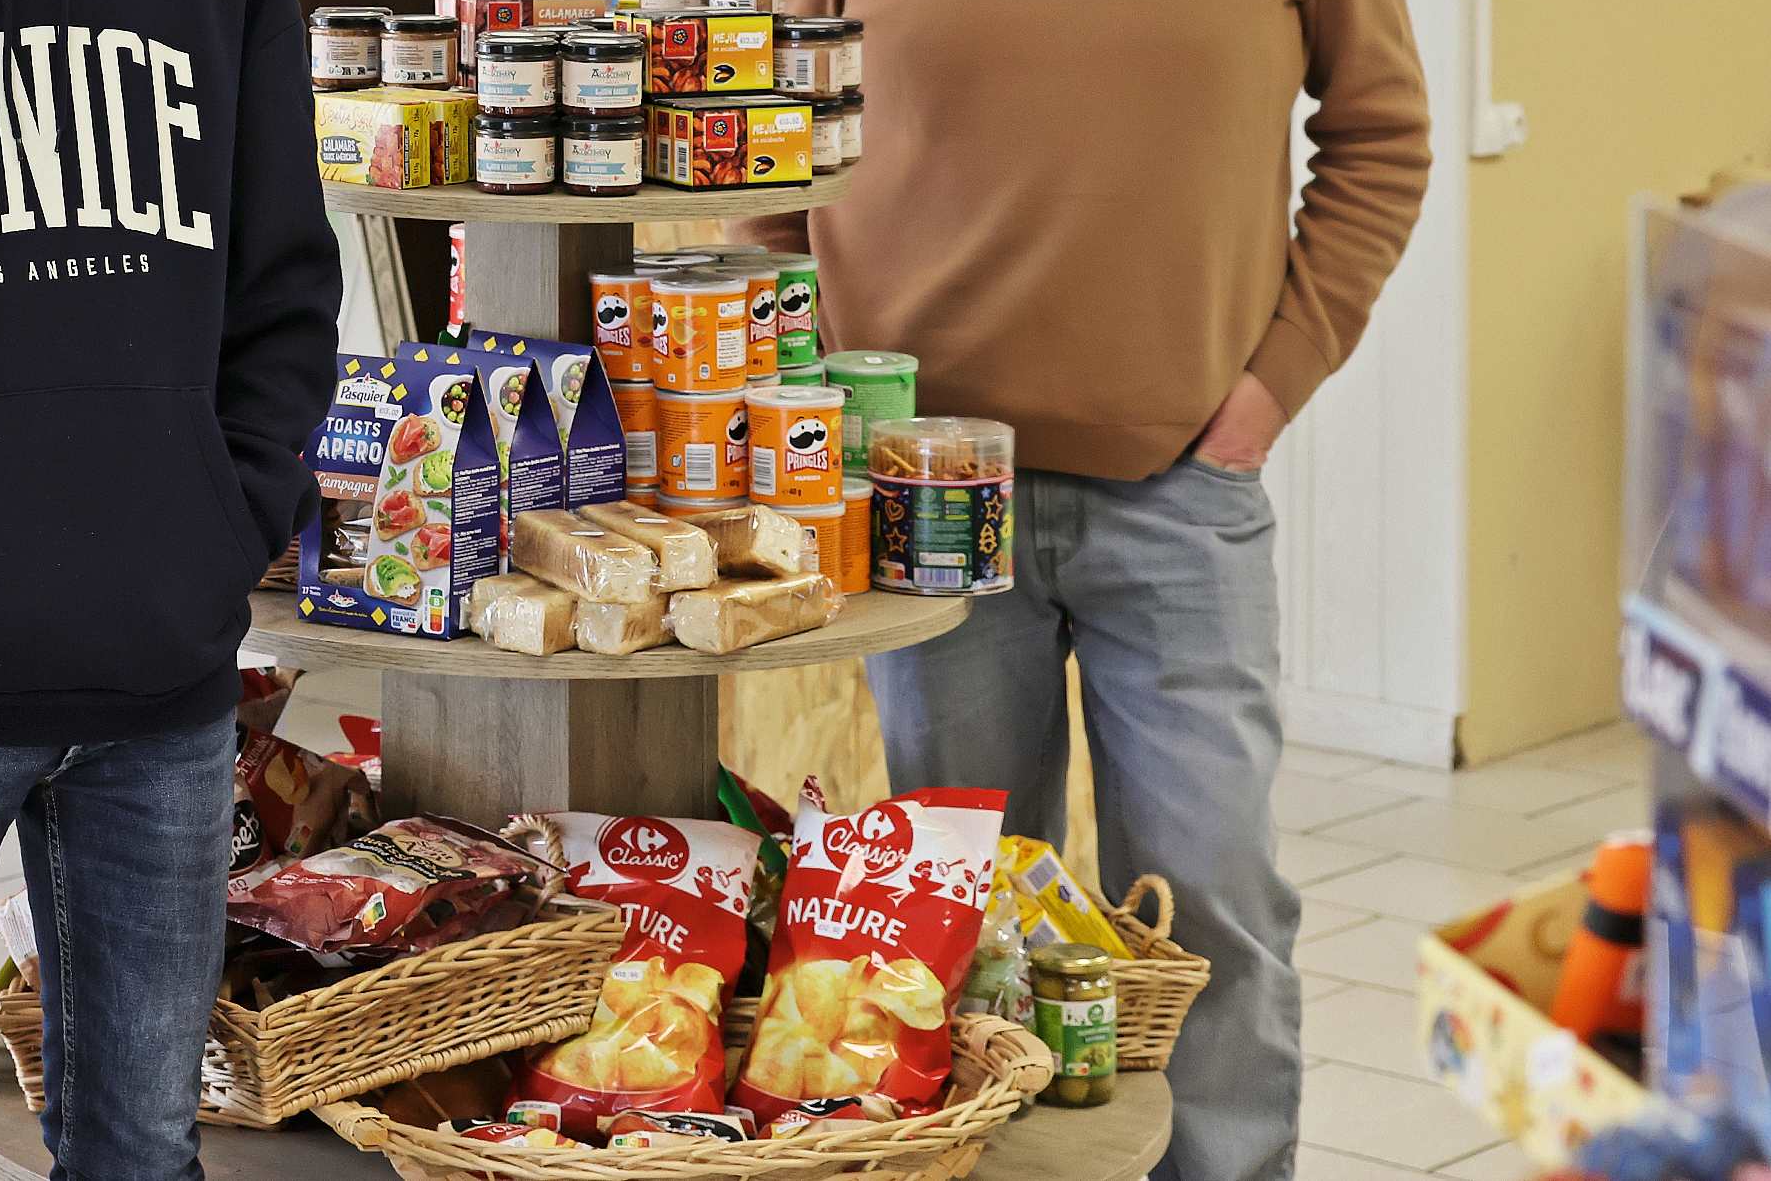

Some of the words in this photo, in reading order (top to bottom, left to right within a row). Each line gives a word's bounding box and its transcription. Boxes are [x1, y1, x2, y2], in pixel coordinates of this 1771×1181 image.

[539, 7, 595, 19] CALAMARES
[323, 137, 356, 152] CALAMARS
[28, 254, 150, 282] ANGELES
[340, 385, 386, 404] Pasquier
[326, 416, 382, 438] TOASTS
[316, 436, 384, 465] APERO
[787, 449, 829, 472] PRINGLES
[317, 472, 375, 498] Campagne
[607, 846, 683, 869] Classic
[620, 902, 690, 953] TURE
[786, 897, 907, 947] NATURE
